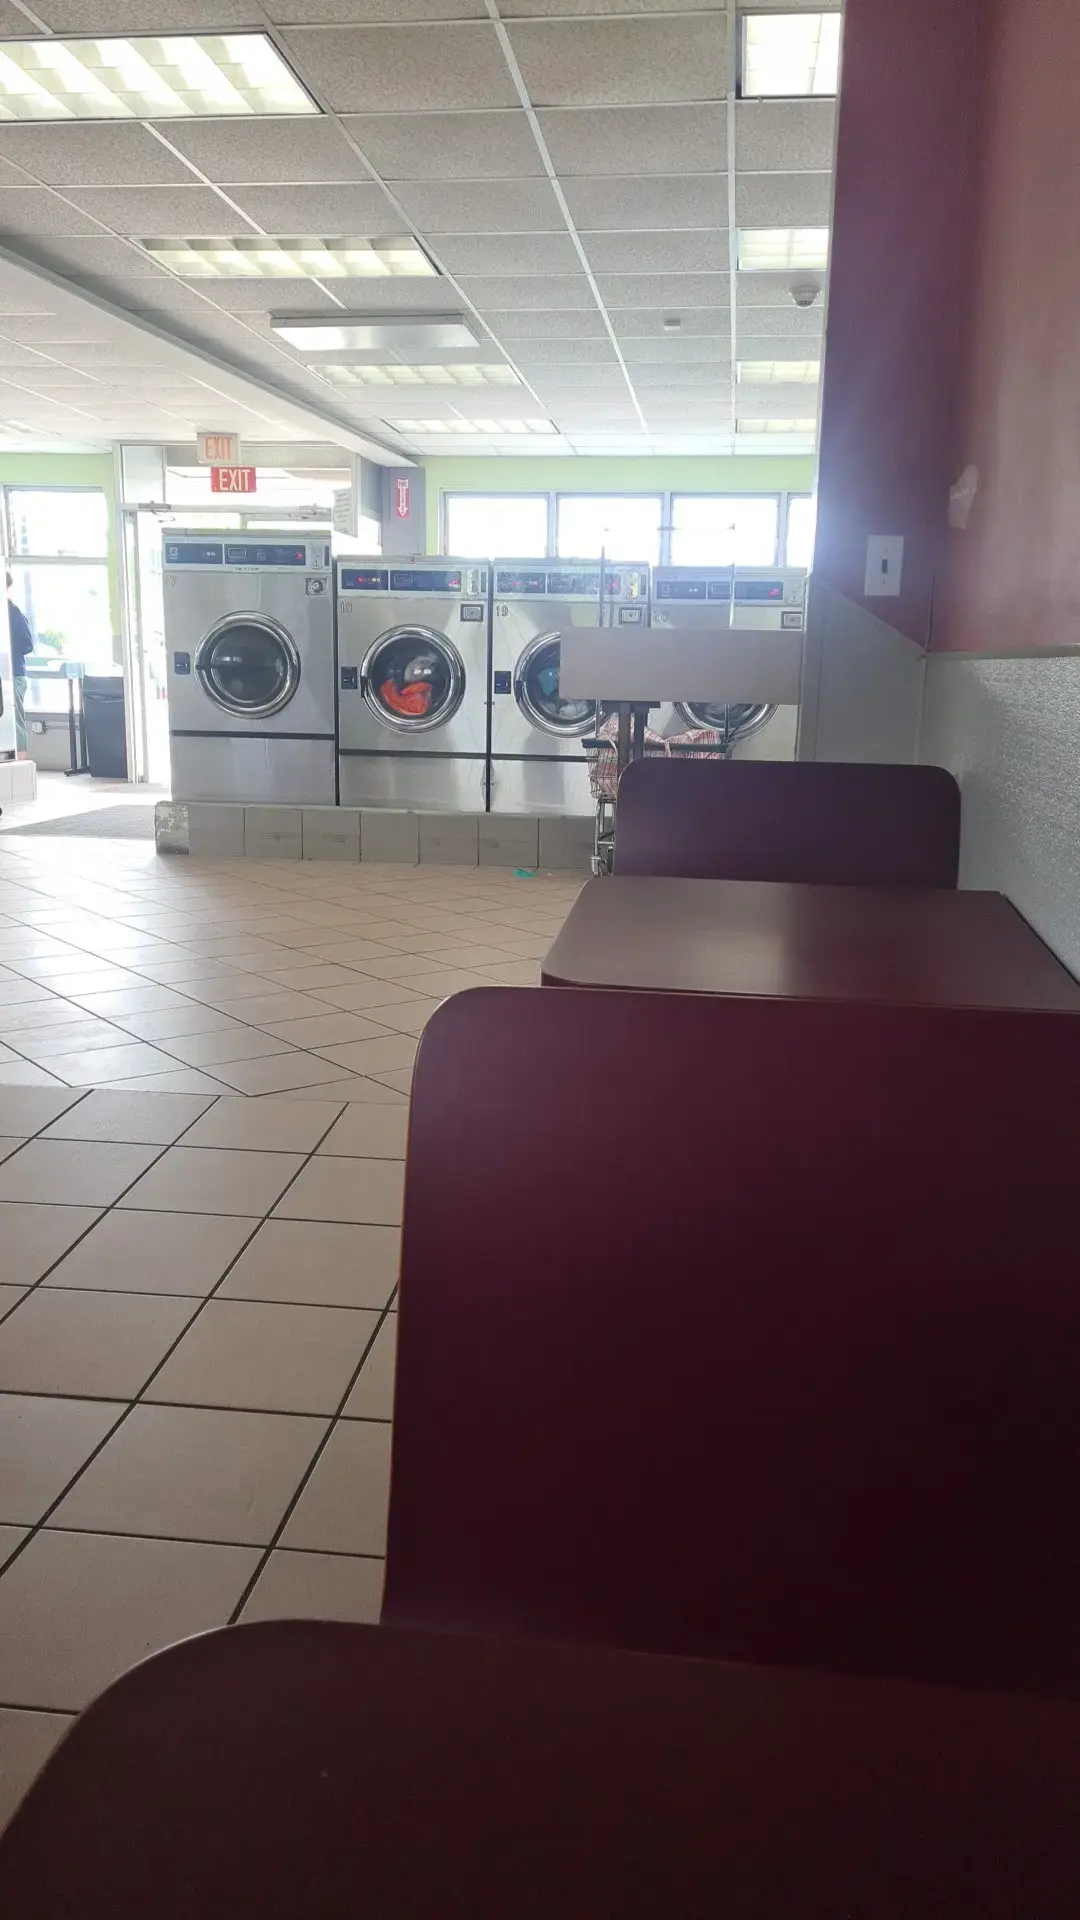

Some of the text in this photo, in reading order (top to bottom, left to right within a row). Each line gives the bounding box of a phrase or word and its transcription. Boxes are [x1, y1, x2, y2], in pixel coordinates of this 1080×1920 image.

[205, 436, 232, 459] EXIT
[219, 469, 250, 491] EXIT
[496, 605, 509, 617] 19
